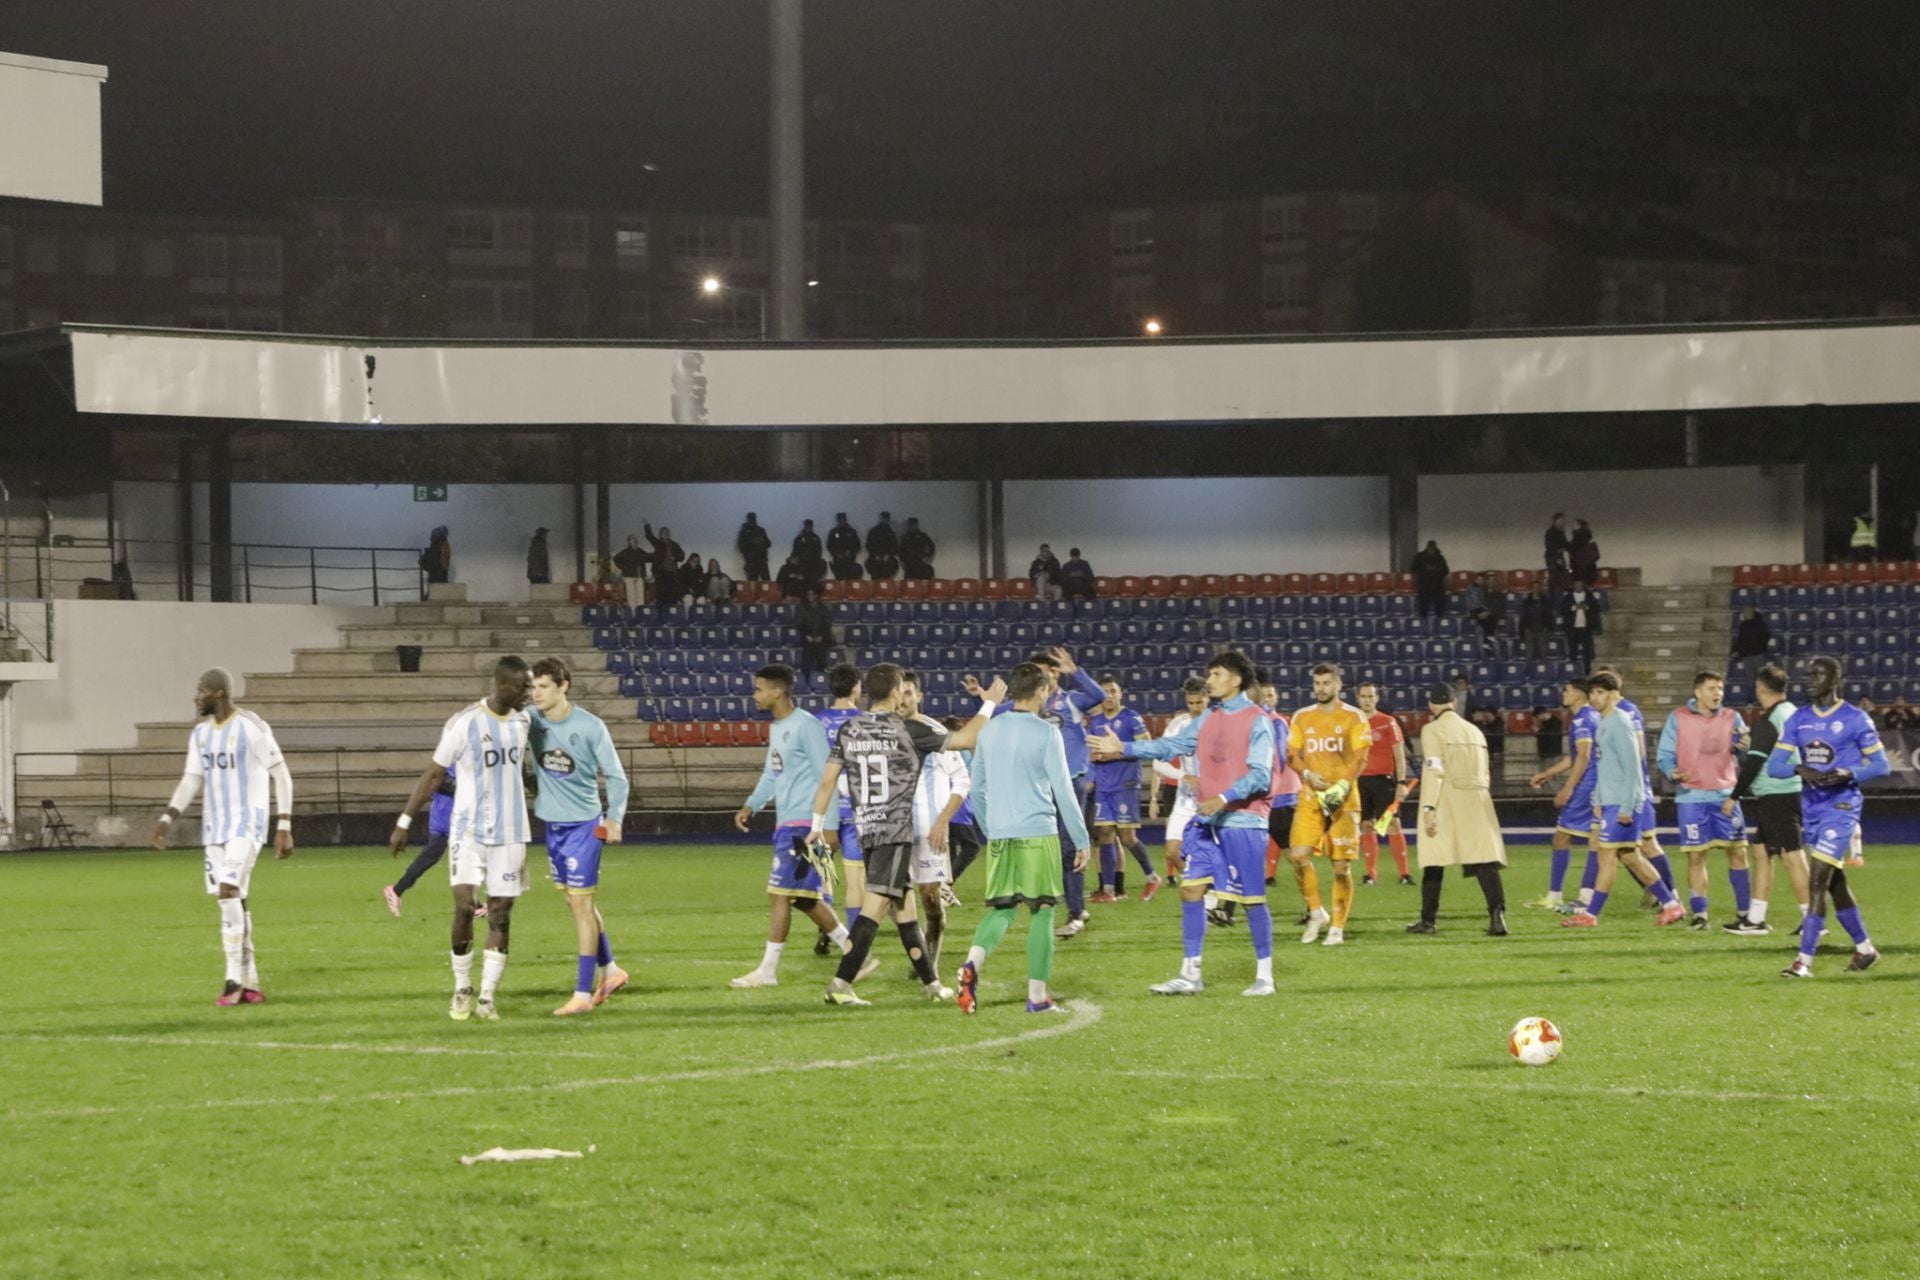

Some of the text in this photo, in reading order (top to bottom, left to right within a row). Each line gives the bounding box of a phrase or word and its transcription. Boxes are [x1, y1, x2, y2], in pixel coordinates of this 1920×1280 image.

[846, 741, 881, 752] ALBERTO
[1305, 737, 1344, 753] DIGI
[857, 754, 890, 804] 13
[1685, 823, 1700, 840] 16
